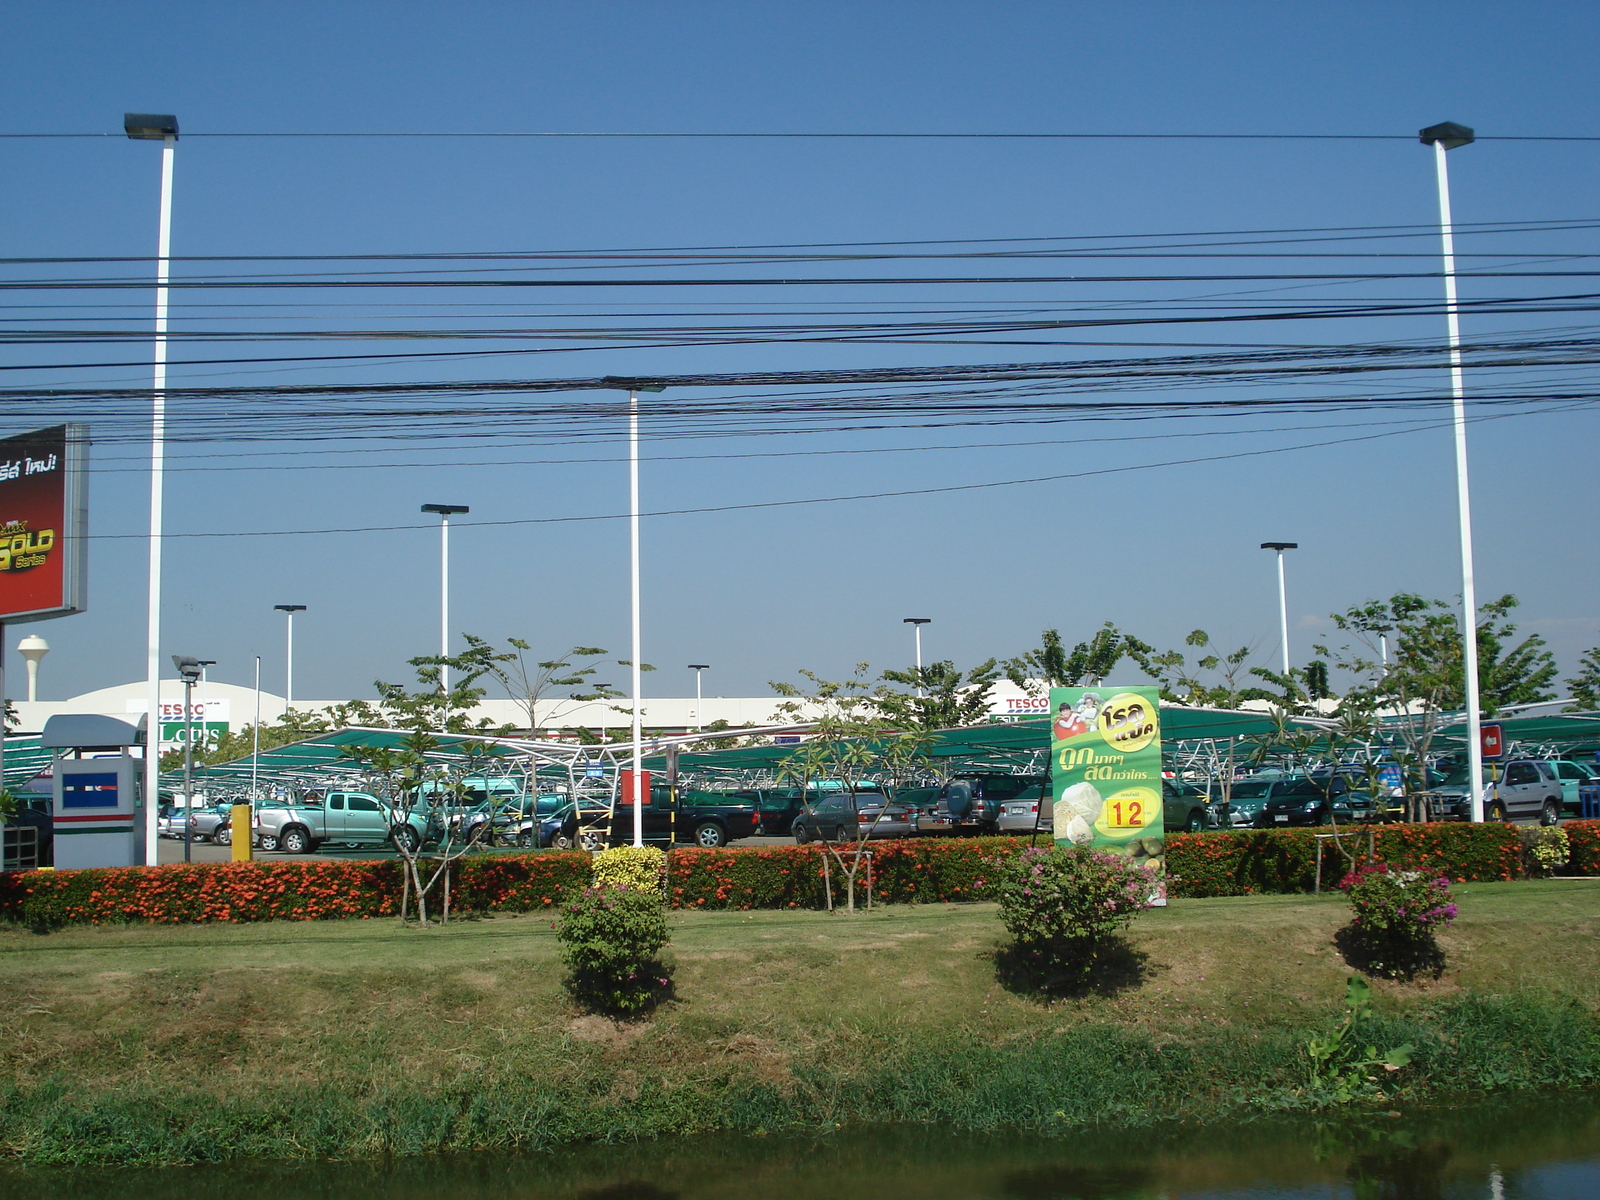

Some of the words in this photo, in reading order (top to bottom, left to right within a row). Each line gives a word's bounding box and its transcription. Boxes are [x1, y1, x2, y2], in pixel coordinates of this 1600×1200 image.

[25, 454, 56, 475] ใหม่!
[15, 554, 46, 568] Series
[158, 704, 206, 715] ESO
[1006, 698, 1049, 708] TESCO
[1101, 704, 1146, 731] โรล
[1113, 801, 1142, 826] 12
